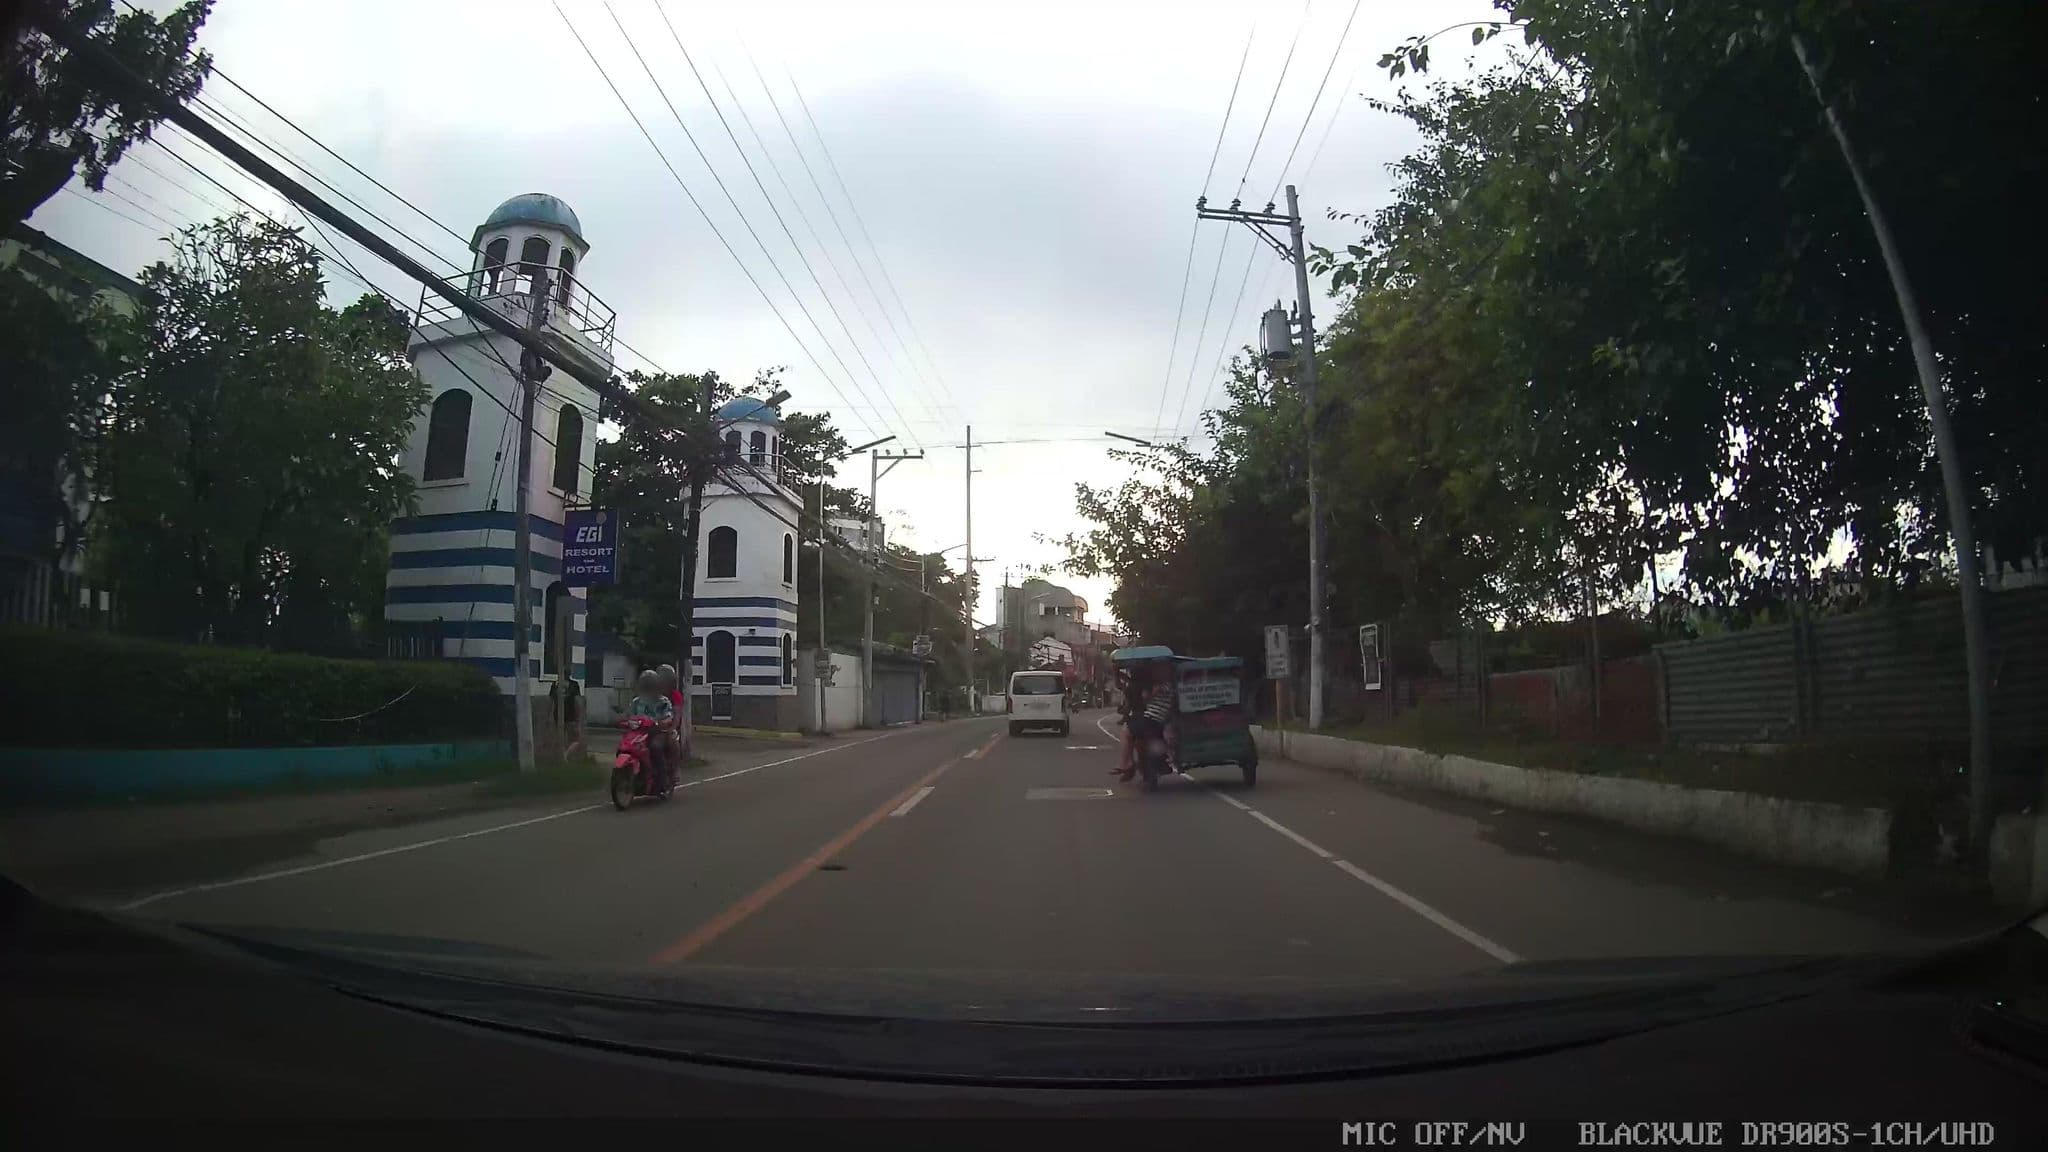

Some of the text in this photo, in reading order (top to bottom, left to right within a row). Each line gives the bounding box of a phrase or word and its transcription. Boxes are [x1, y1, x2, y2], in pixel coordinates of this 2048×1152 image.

[576, 526, 603, 543] EGI
[565, 548, 614, 557] RESORT
[566, 565, 610, 574] HOTEL
